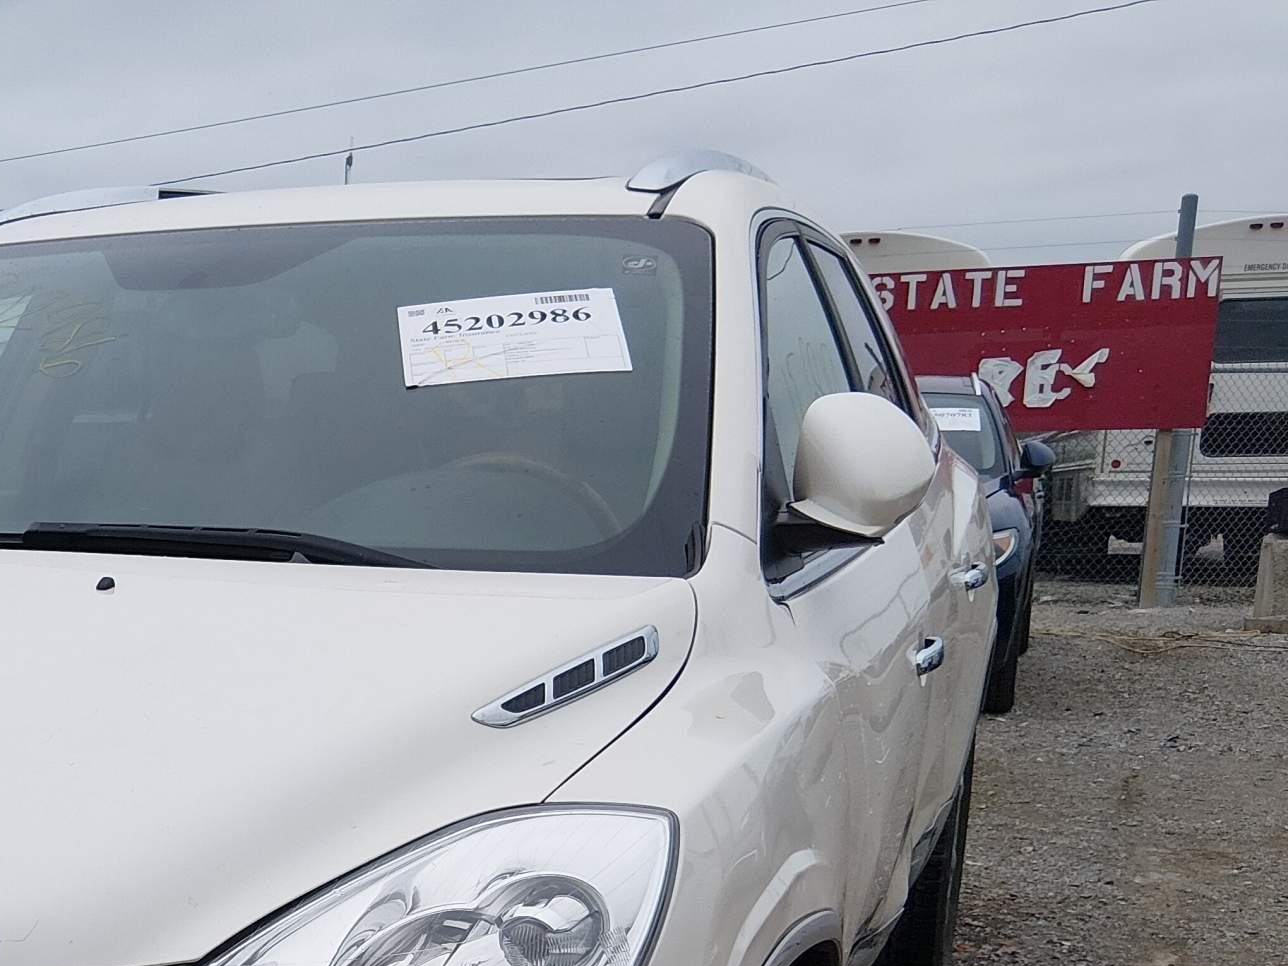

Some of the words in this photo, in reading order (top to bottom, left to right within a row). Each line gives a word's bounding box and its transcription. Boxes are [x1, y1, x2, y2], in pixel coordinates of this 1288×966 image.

[872, 270, 1026, 311] STATE
[1082, 259, 1220, 303] FARM
[422, 306, 592, 335] 45202986
